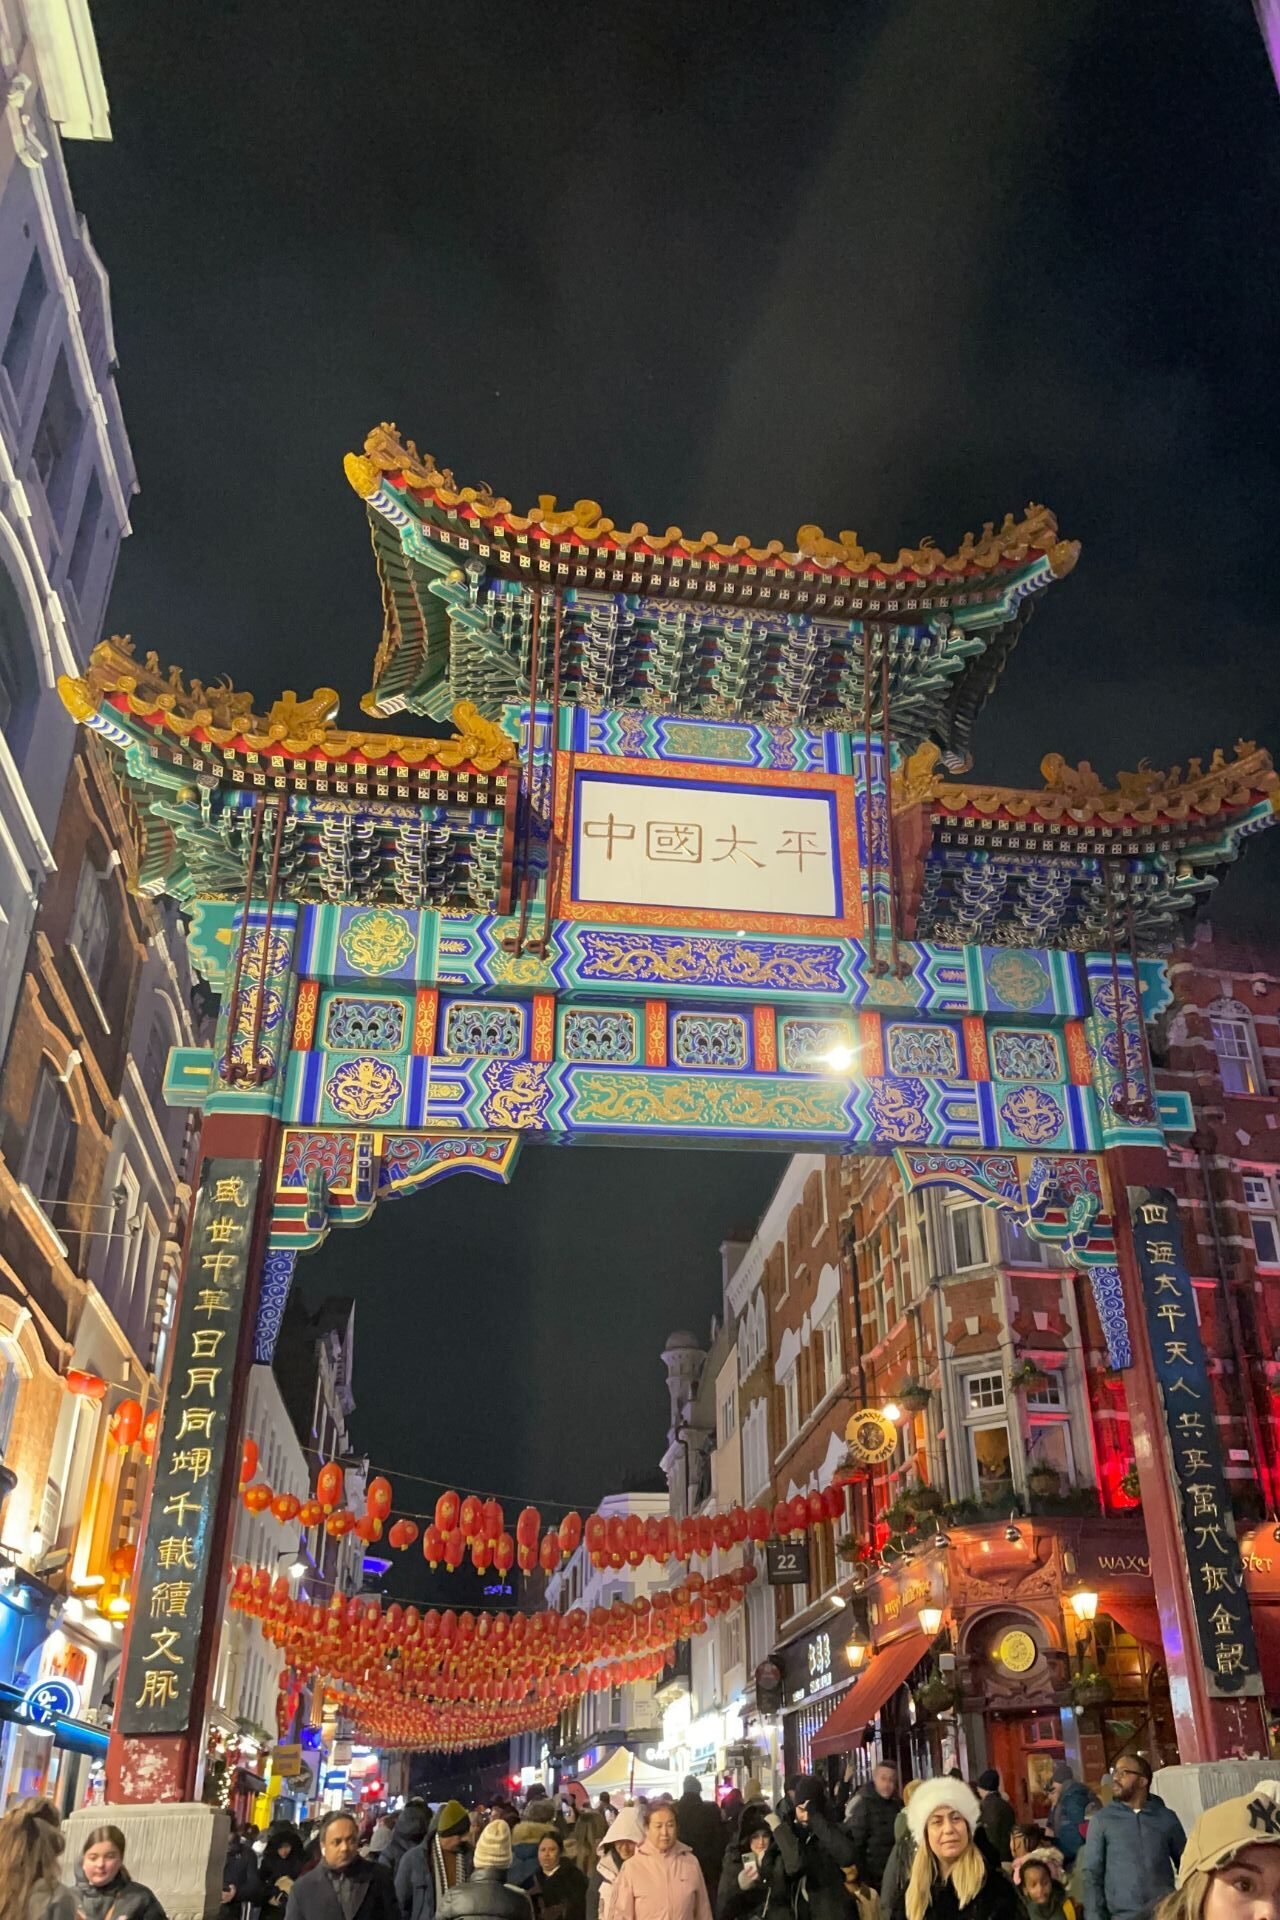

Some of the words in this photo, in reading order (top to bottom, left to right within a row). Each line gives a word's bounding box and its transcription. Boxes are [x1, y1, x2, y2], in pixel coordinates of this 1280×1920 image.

[583, 812, 827, 873] 中國太平
[777, 1554, 797, 1570] 22
[1241, 1552, 1274, 1573] ster
